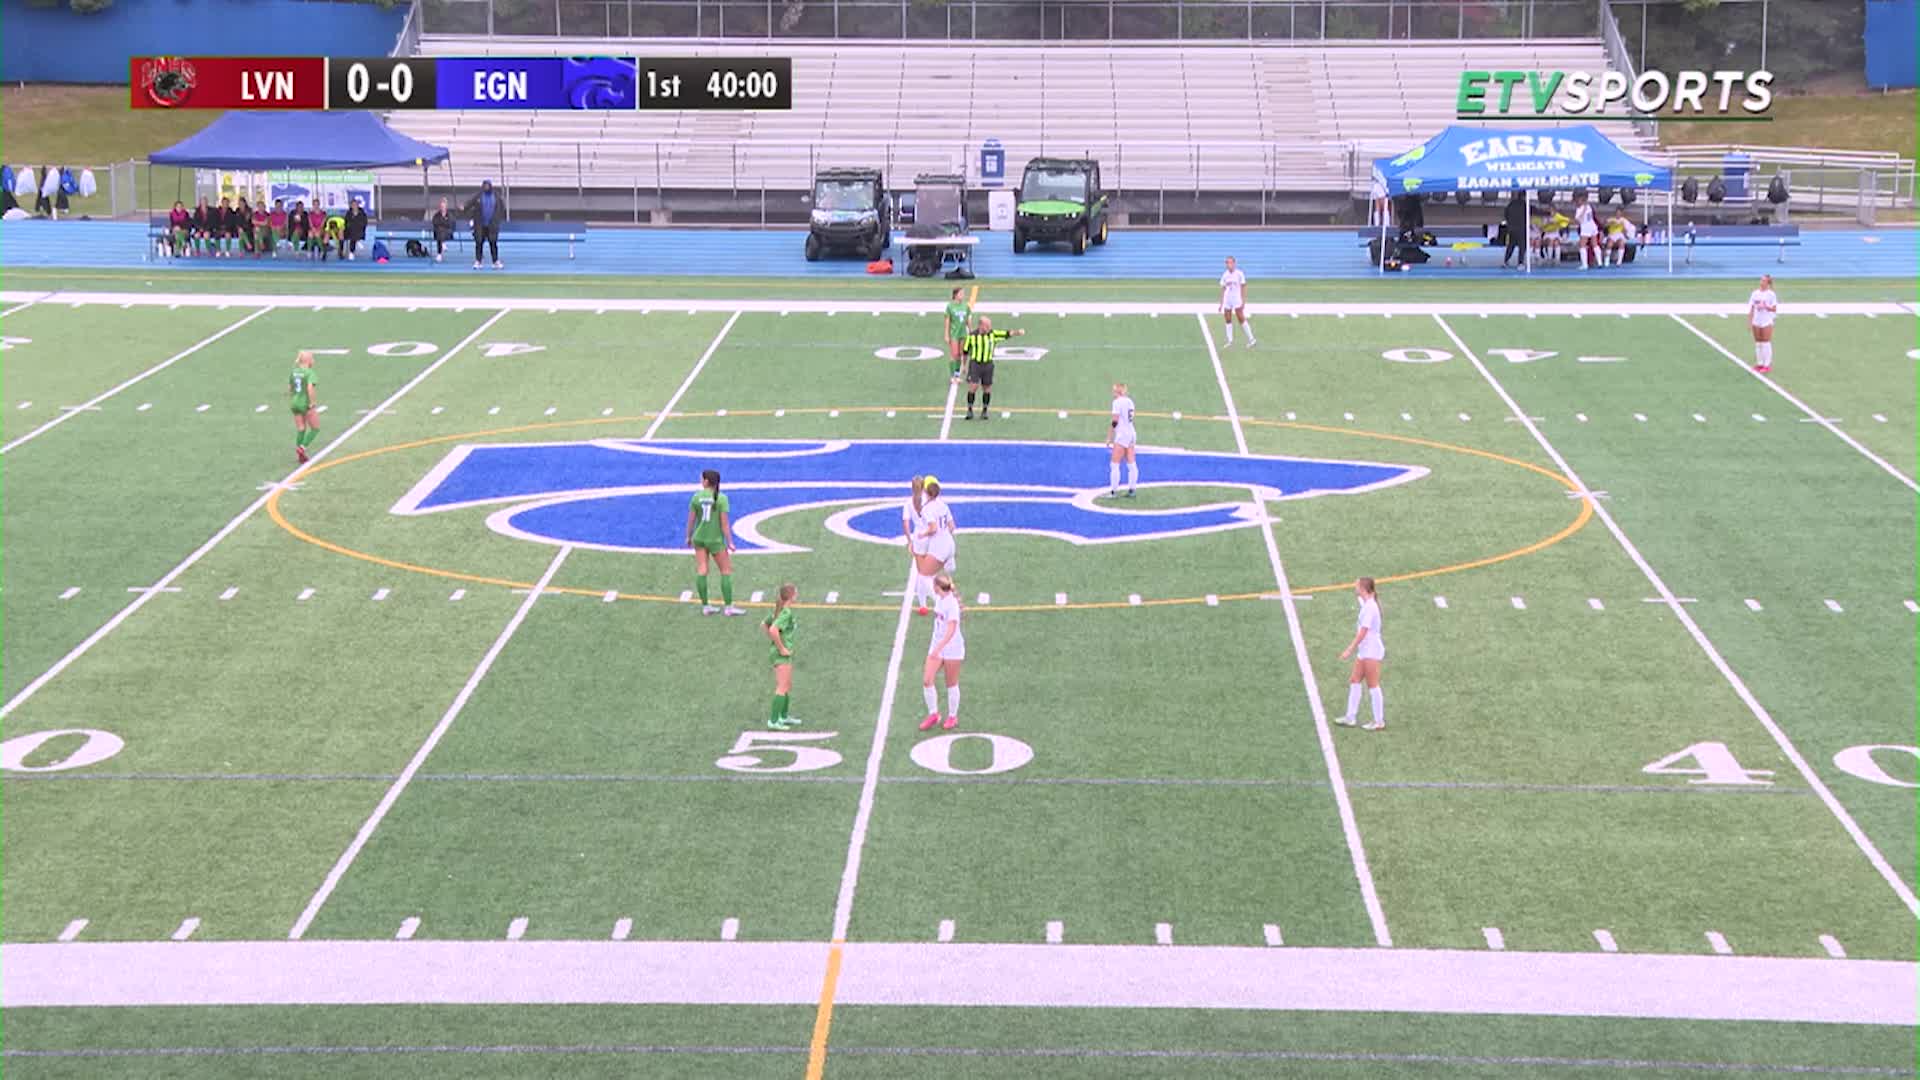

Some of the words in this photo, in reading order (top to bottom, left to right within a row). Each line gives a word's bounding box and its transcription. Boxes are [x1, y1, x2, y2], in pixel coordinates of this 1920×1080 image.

[1459, 135, 1587, 167] EAGAN
[1486, 160, 1566, 172] WILDCATS
[1457, 176, 1513, 189] EAGAN
[1516, 172, 1600, 187] WILDCATS
